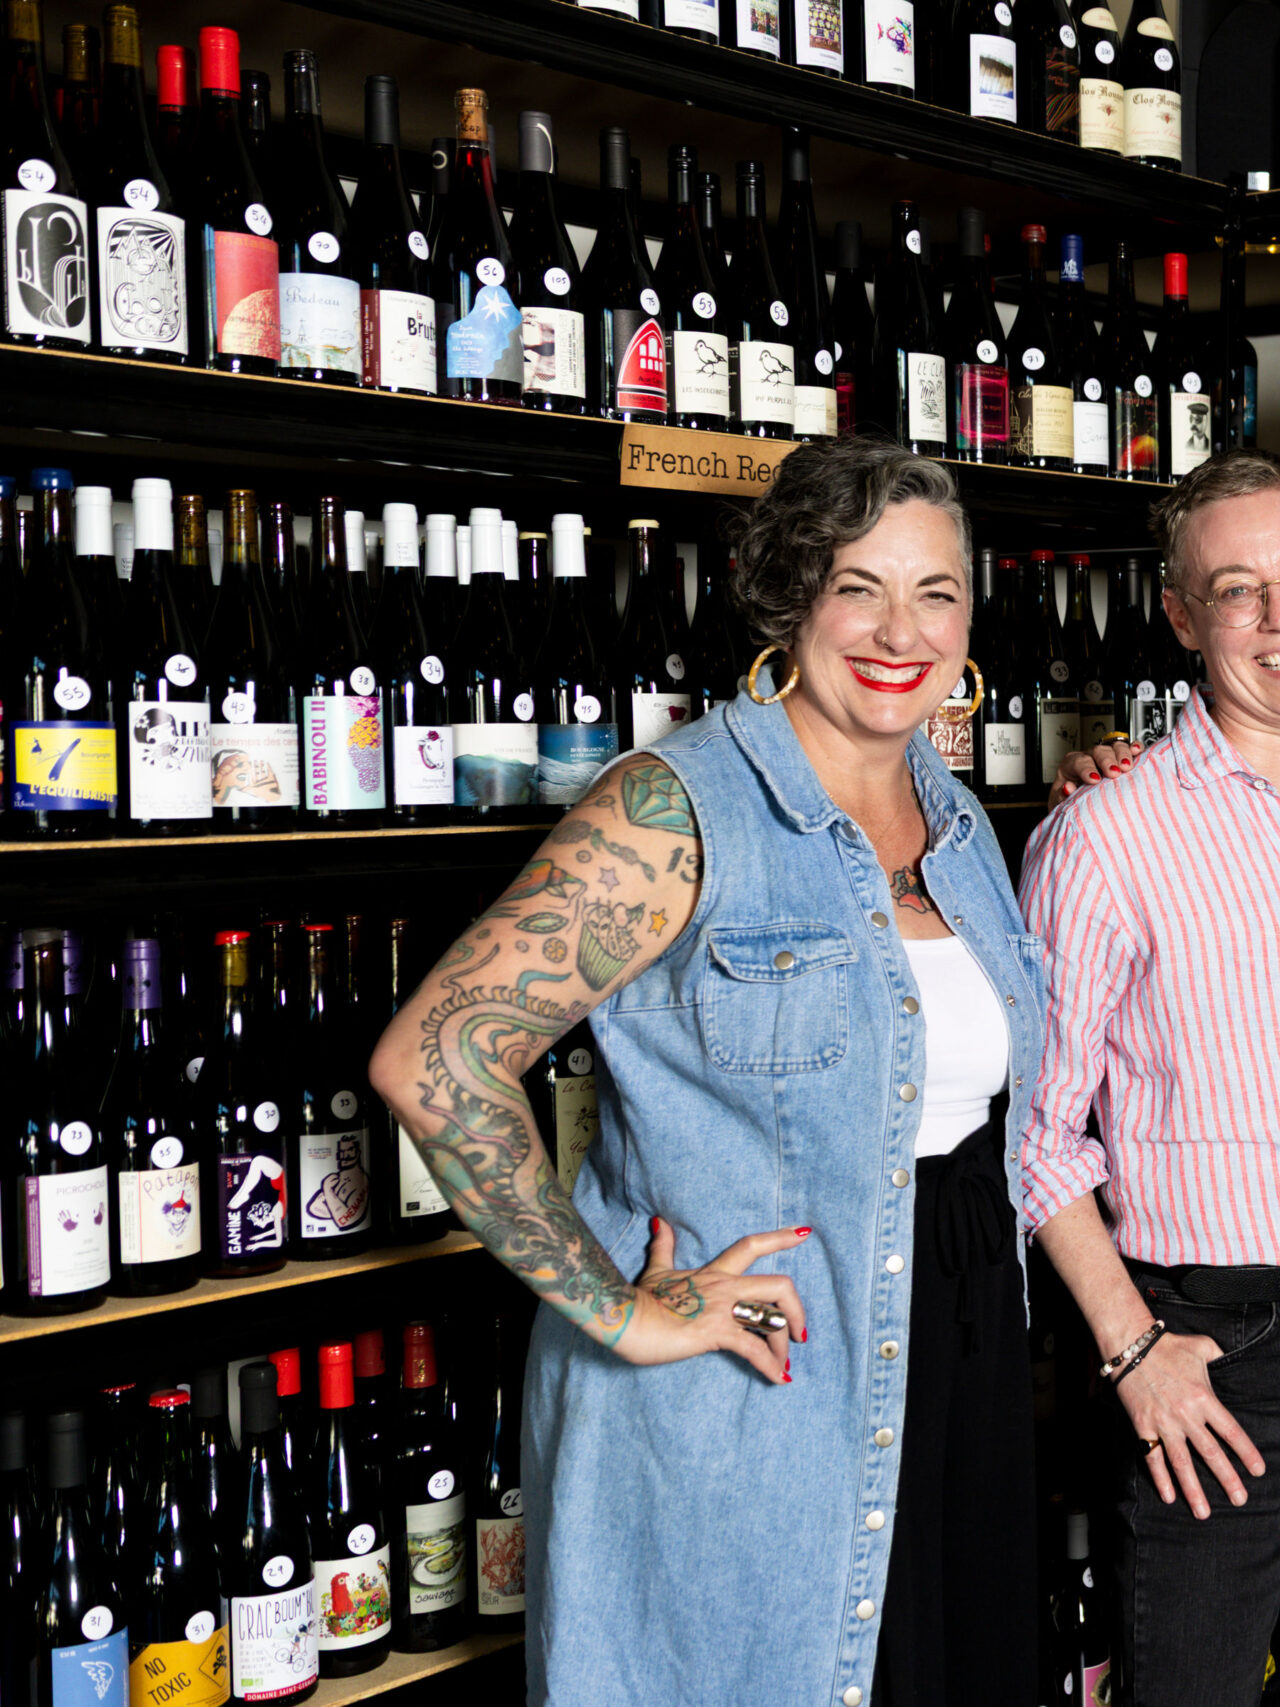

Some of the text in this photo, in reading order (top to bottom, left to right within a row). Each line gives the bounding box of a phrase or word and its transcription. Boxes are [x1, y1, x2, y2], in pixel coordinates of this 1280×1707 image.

[20, 168, 45, 182] 54
[129, 186, 150, 202] 54
[482, 264, 499, 277] 56
[550, 275, 568, 286] 105
[286, 286, 342, 307] Bedeau
[698, 297, 714, 315] 53
[773, 305, 787, 320] 52
[627, 442, 730, 480] French
[426, 661, 442, 678] 34
[61, 686, 85, 702] 55
[310, 718, 329, 806] BABINOU
[29, 783, 115, 803] L'EQUILIBRISTE
[570, 1054, 586, 1066] 41
[433, 1476, 448, 1488] 25
[502, 1492, 521, 1511] 26
[349, 1533, 368, 1549] 25
[266, 1564, 284, 1578] 29
[90, 1615, 102, 1628] 31
[238, 1597, 303, 1642] CRAC BOUM
[191, 1623, 206, 1637] 31
[142, 1656, 168, 1681] NO
[147, 1670, 193, 1707] TOXIC
[246, 1689, 278, 1703] DOMAINE
